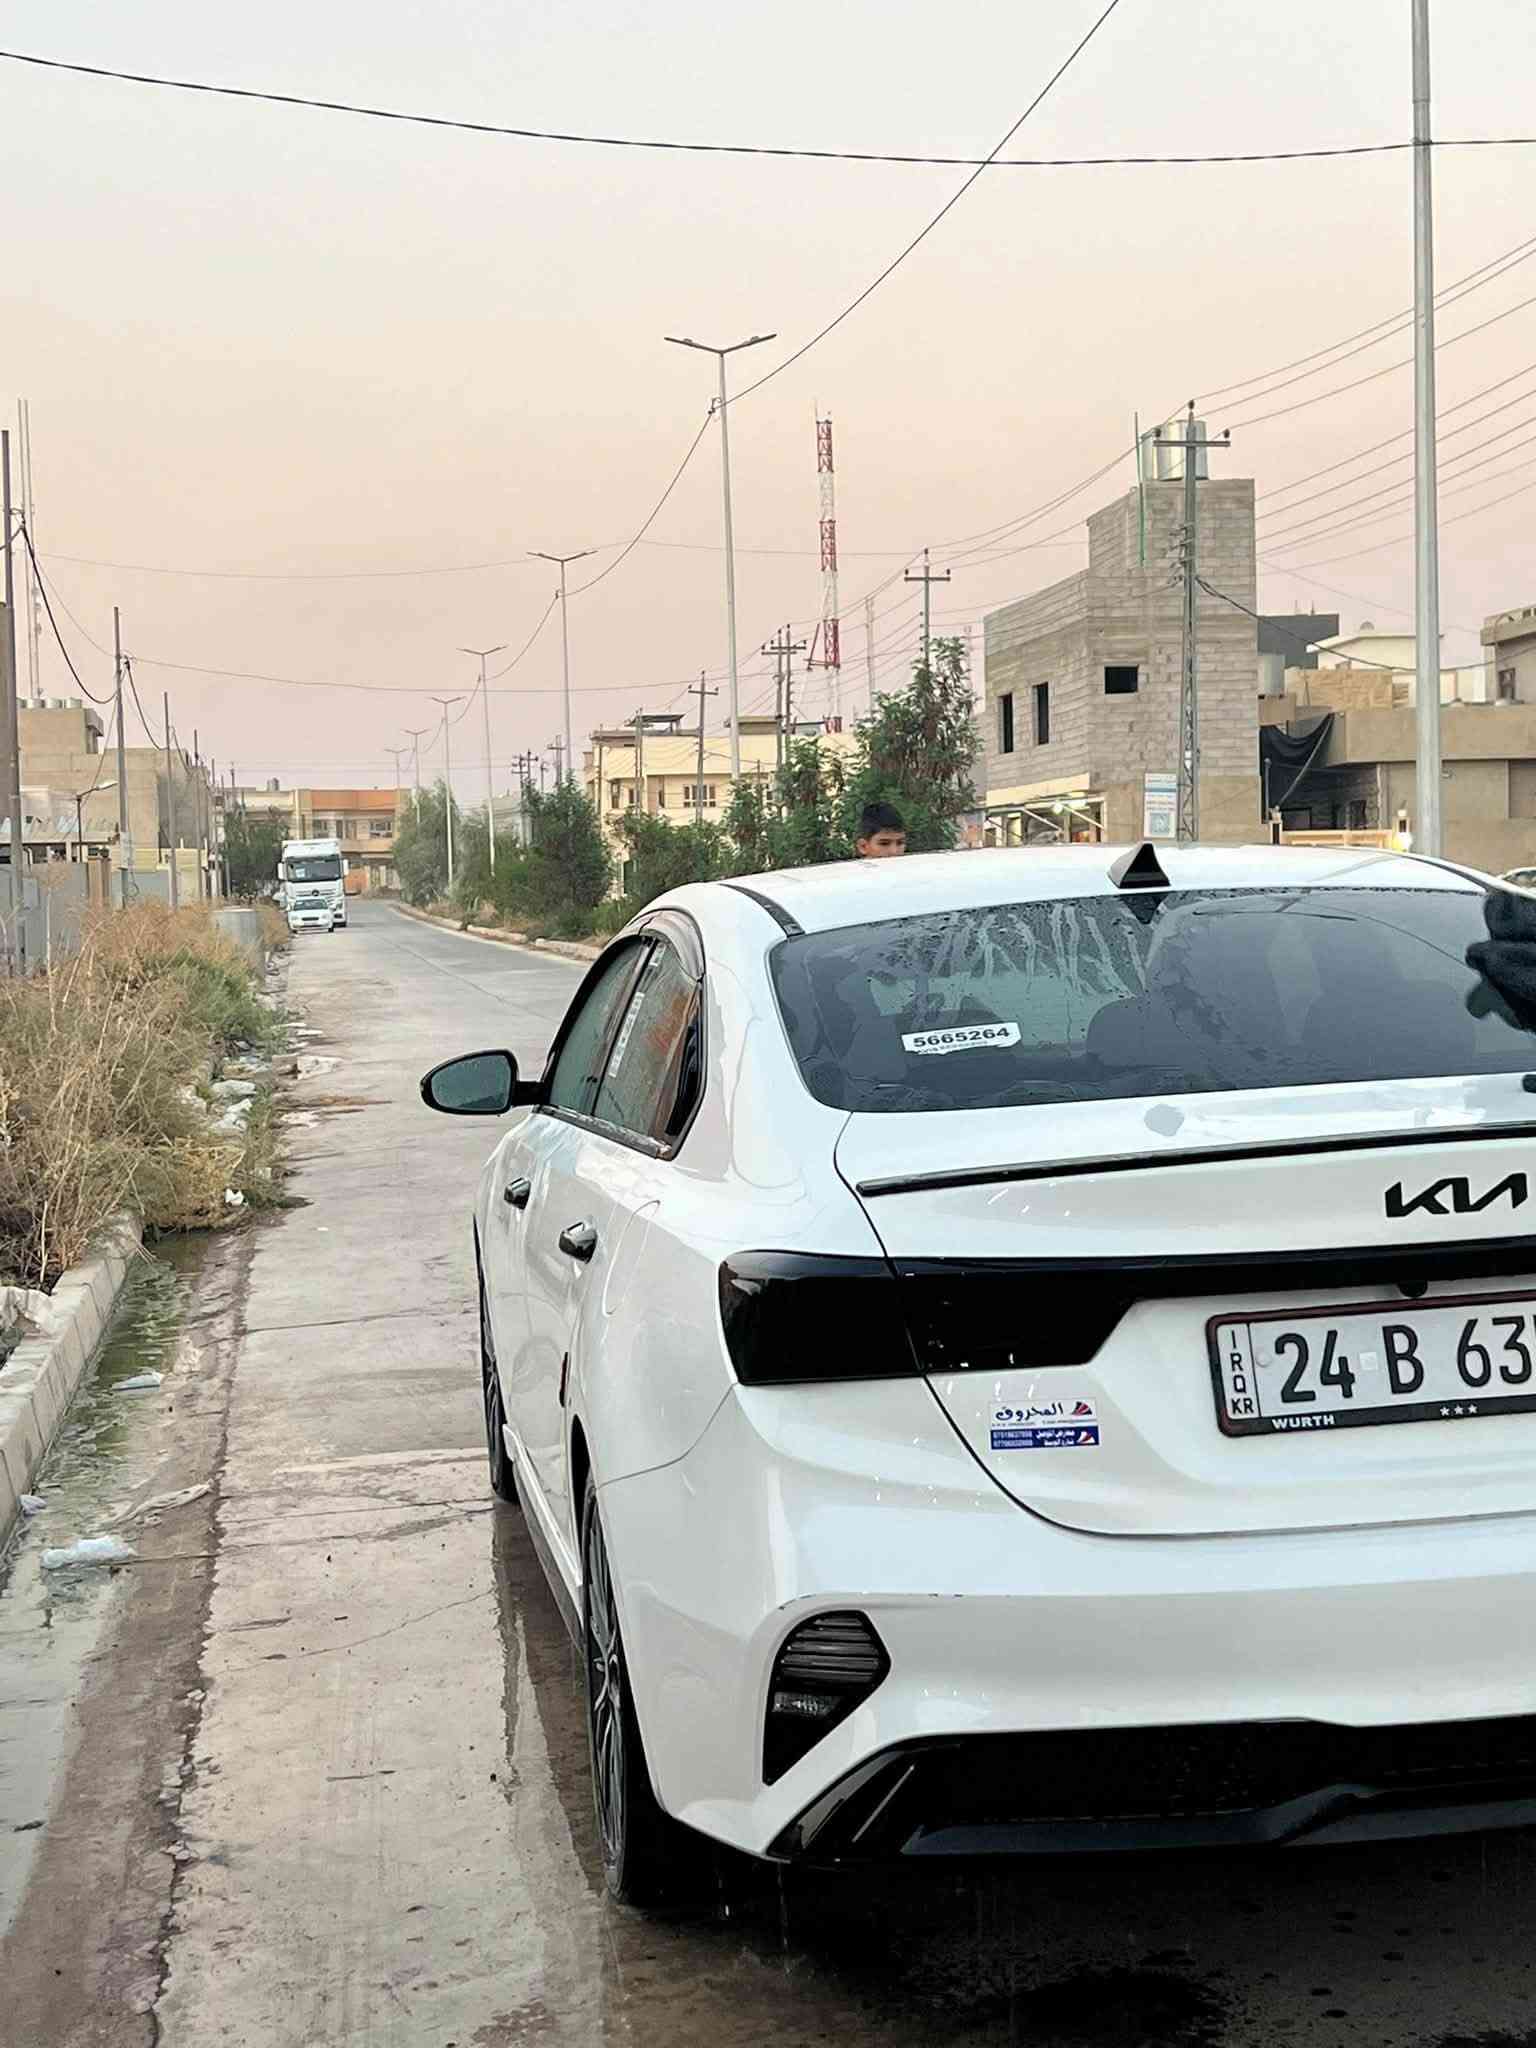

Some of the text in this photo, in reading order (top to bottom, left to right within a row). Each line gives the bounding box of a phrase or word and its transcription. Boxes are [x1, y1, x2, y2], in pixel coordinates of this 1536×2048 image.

[913, 1027, 1010, 1048] 5665264
[1384, 1172, 1528, 1218] KIA
[1274, 1314, 1536, 1403] 24 B 63
[1231, 1397, 1254, 1415] KR
[1272, 1414, 1335, 1430] WURTH
